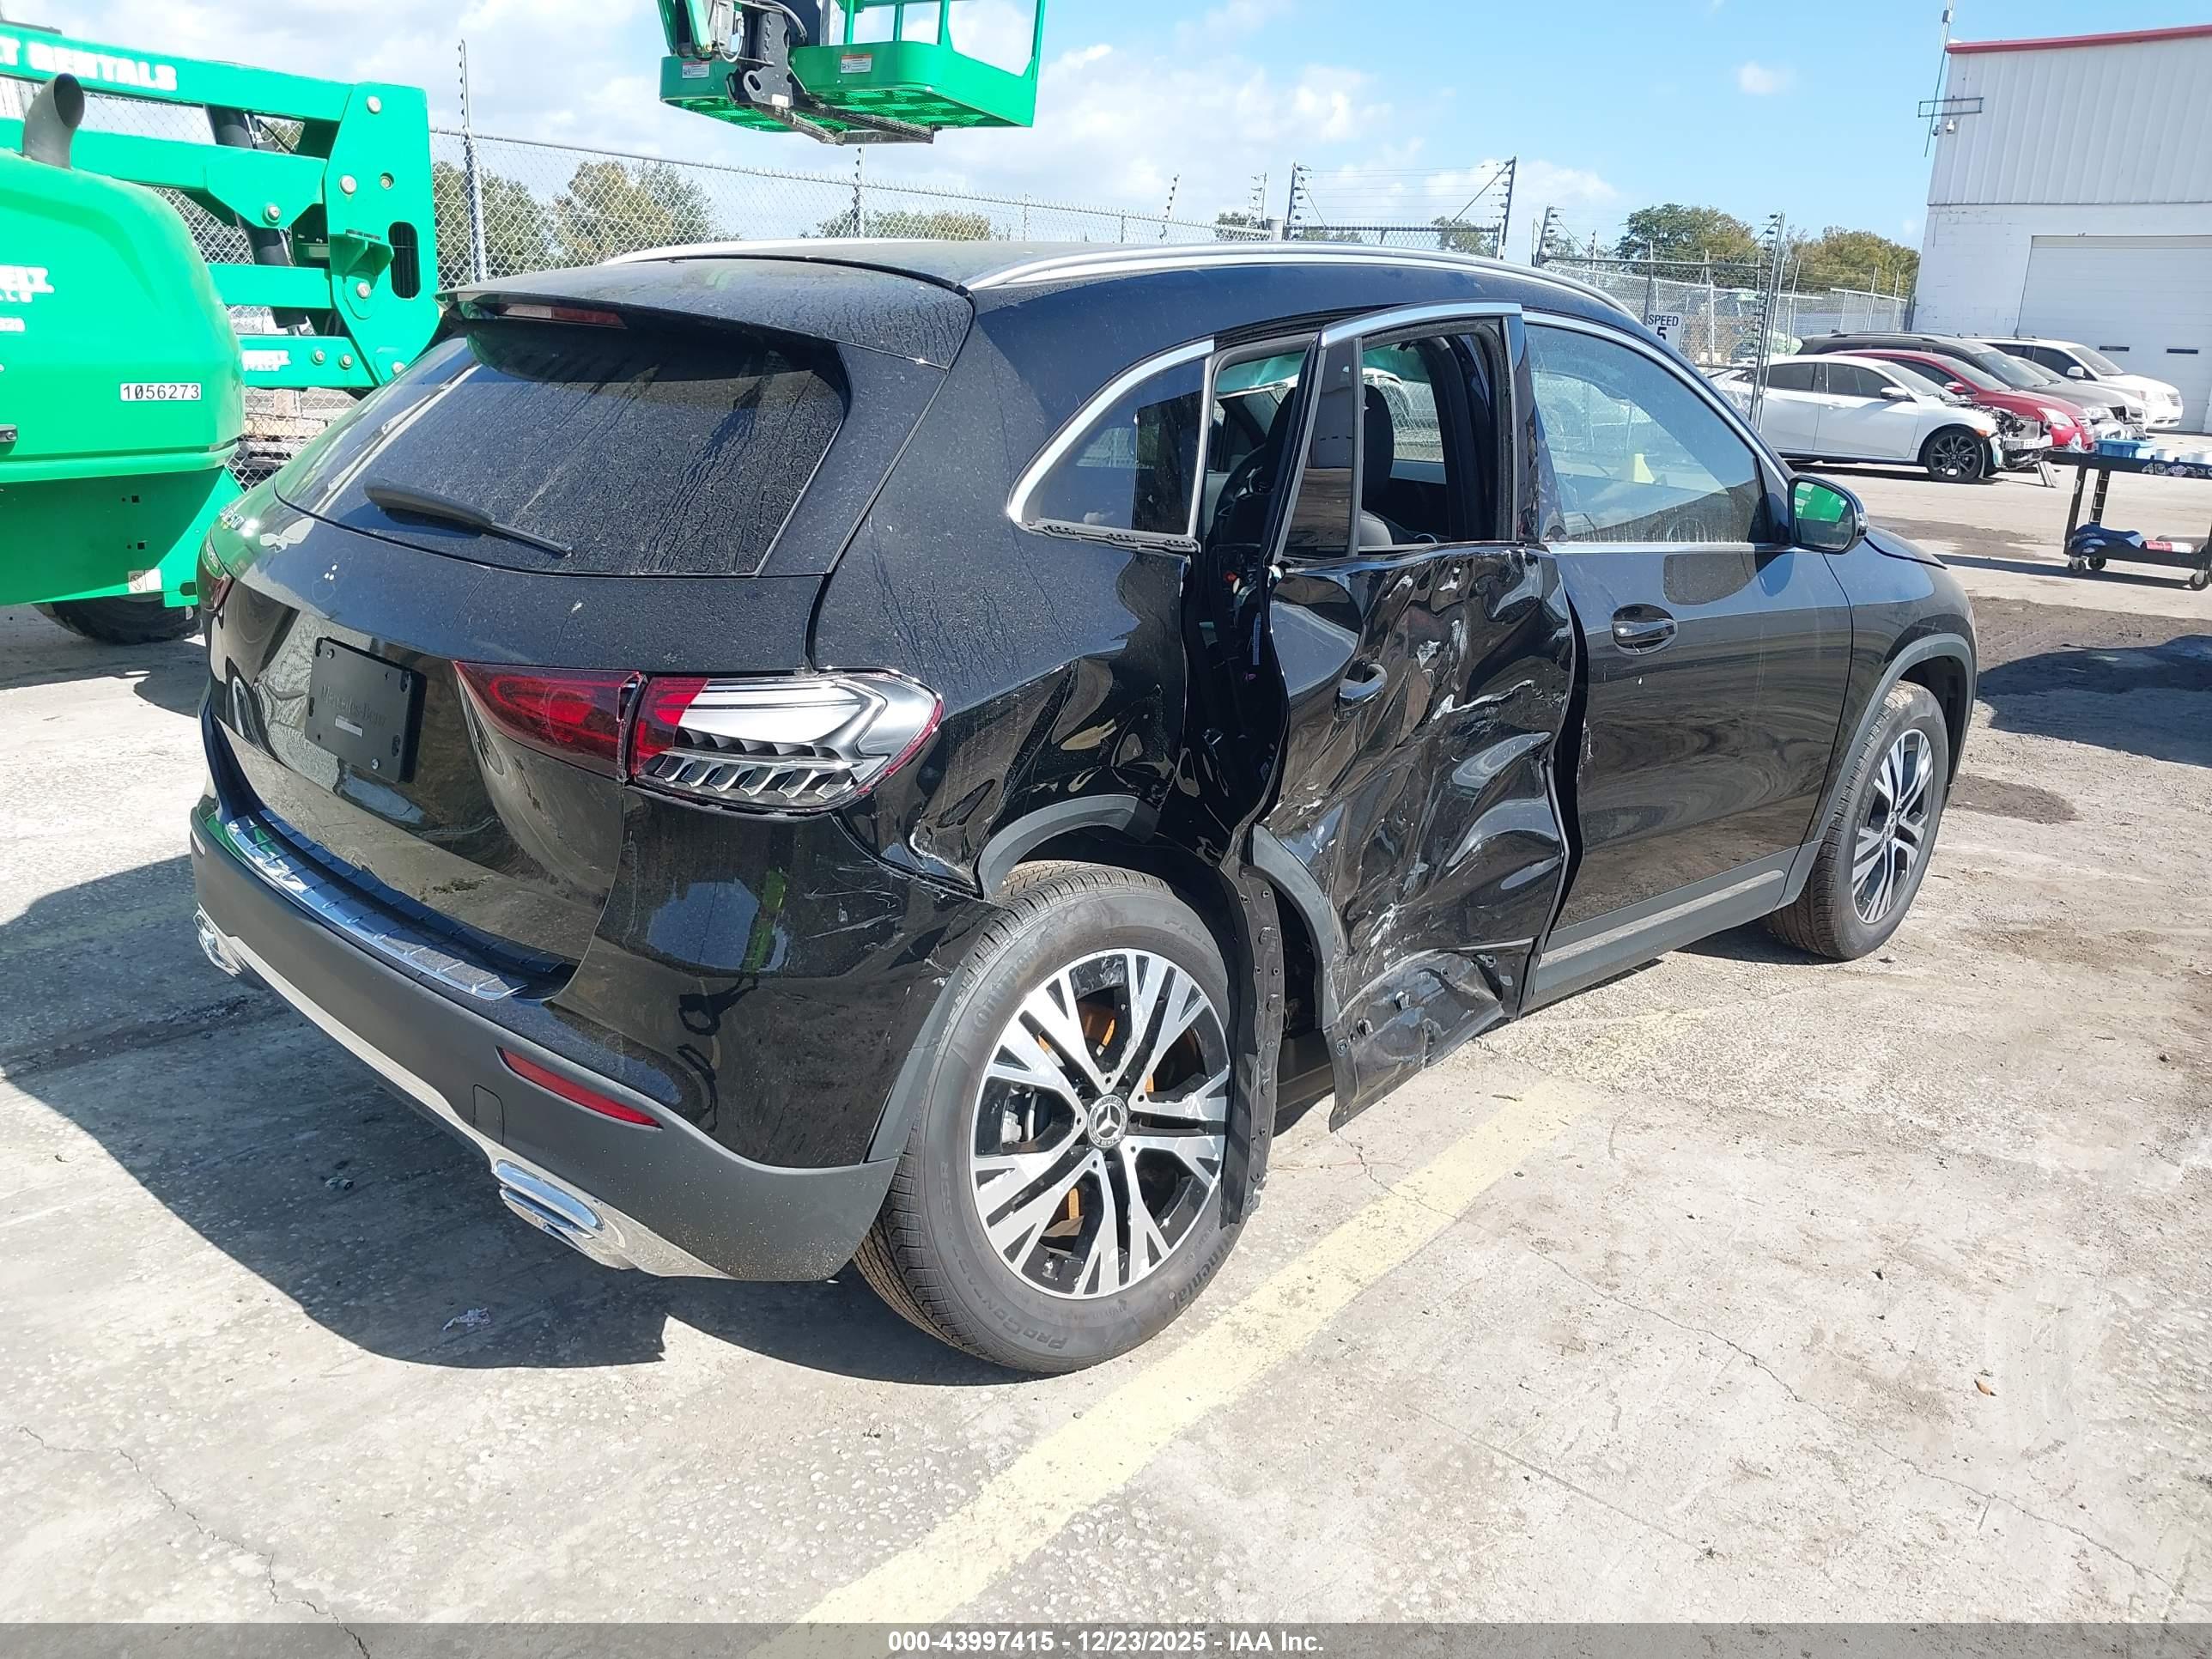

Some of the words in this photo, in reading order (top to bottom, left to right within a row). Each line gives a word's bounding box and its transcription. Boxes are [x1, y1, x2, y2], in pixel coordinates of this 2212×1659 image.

[1648, 314, 1679, 326] SPEED
[1656, 326, 1667, 341] 5
[123, 385, 199, 399] 1056273
[1172, 1225, 1237, 1311] ntinental
